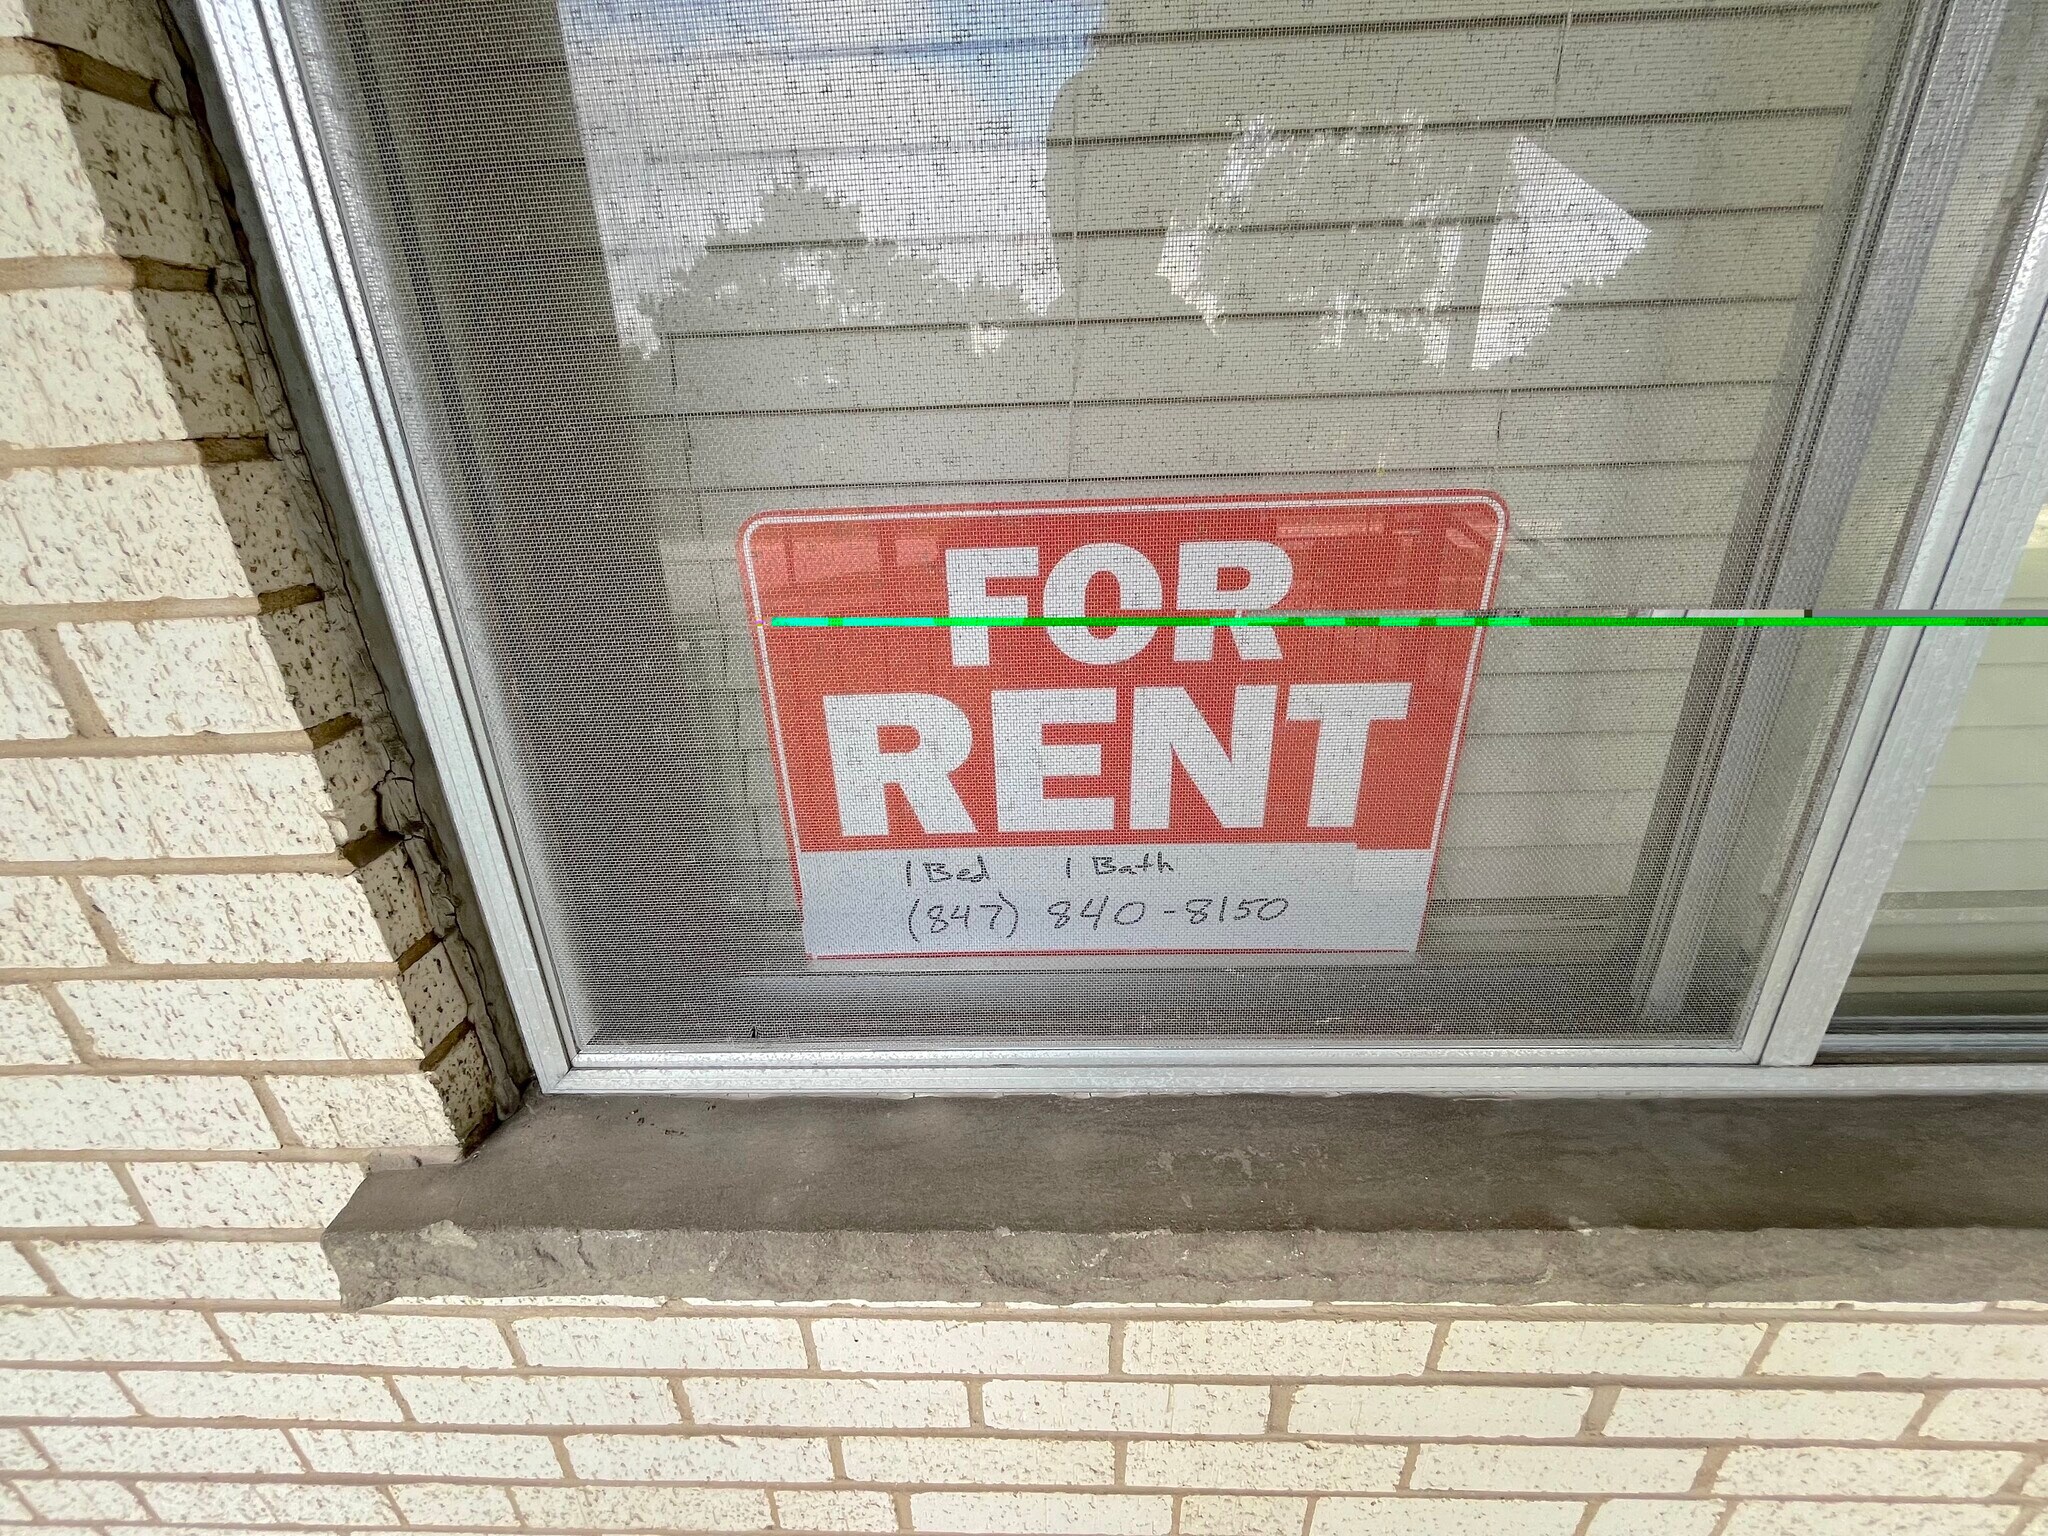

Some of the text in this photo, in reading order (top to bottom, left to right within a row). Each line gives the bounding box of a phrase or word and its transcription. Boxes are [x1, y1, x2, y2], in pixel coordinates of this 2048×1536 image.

[943, 540, 1294, 668] FOR
[821, 682, 1412, 838] RENT
[922, 855, 991, 884] Bed
[1090, 851, 1175, 878] Bath
[907, 891, 1020, 943] (847)
